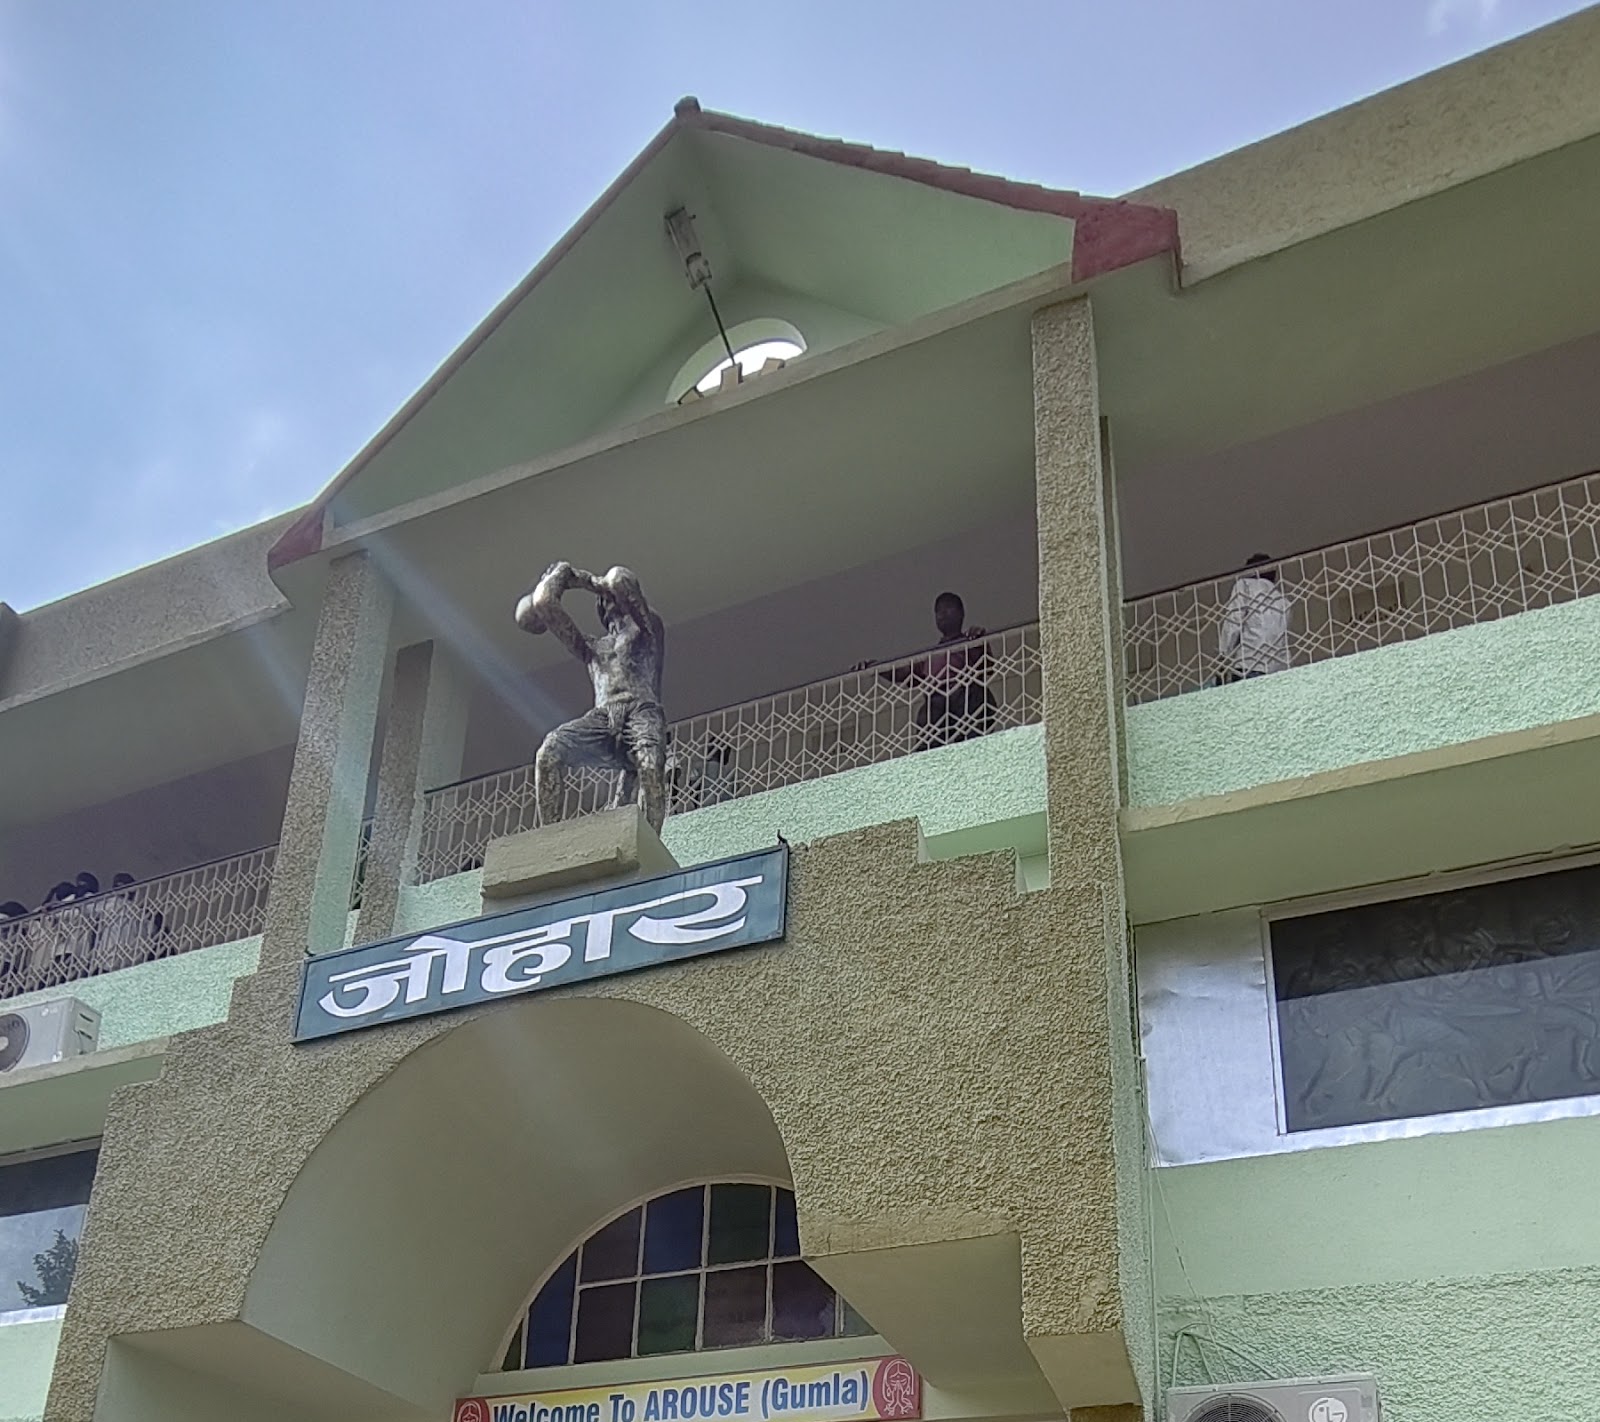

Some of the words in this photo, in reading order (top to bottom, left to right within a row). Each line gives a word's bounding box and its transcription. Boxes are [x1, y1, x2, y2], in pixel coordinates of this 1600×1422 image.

[318, 875, 763, 1017] जोहार
[643, 1381, 750, 1422] AROUSE
[761, 1370, 869, 1419] (Gumla)
